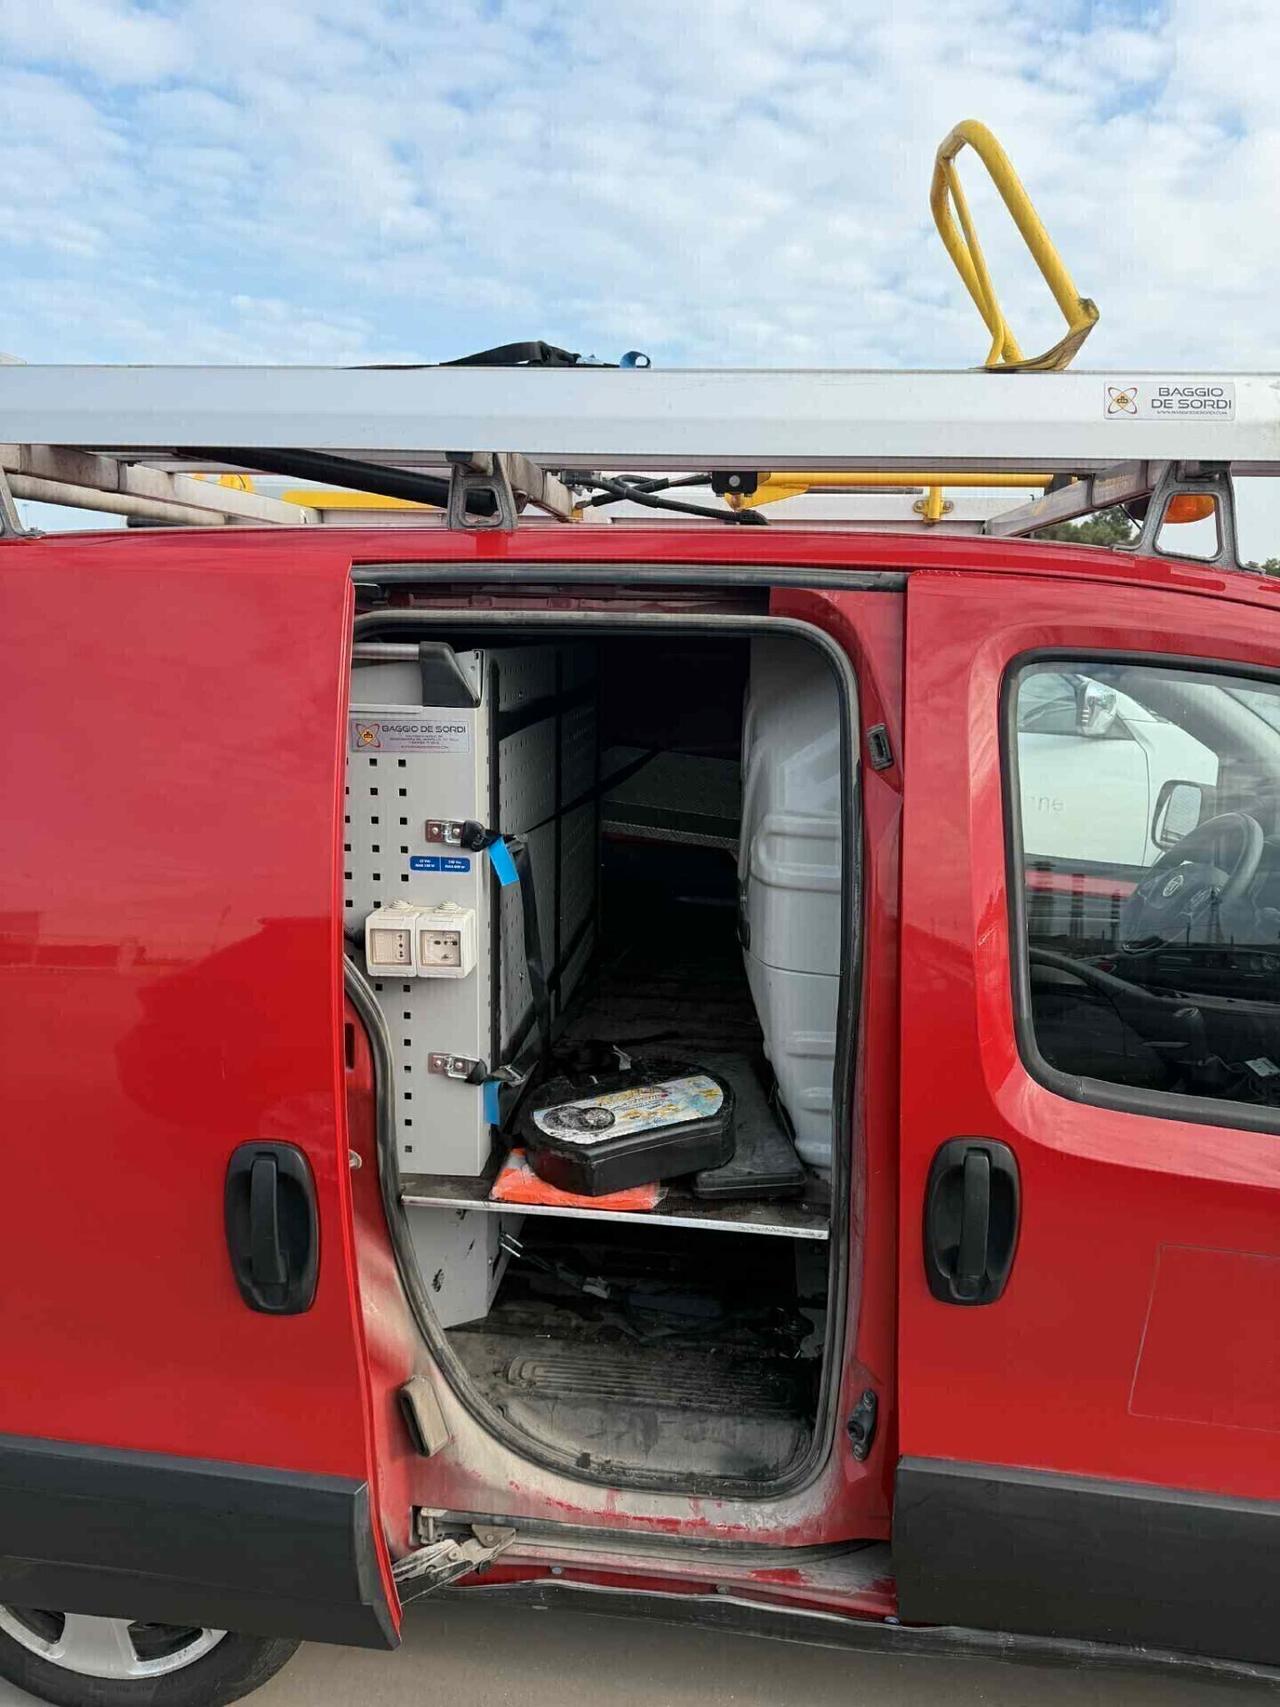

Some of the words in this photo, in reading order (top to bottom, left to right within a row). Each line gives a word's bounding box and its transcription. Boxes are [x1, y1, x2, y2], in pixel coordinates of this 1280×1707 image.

[1158, 387, 1224, 397] BAGGIO
[1151, 398, 1173, 409] DE
[1178, 398, 1232, 410] SORDI
[381, 725, 419, 733] BAGGIO
[420, 725, 434, 733] DE
[435, 725, 466, 733] SORDI
